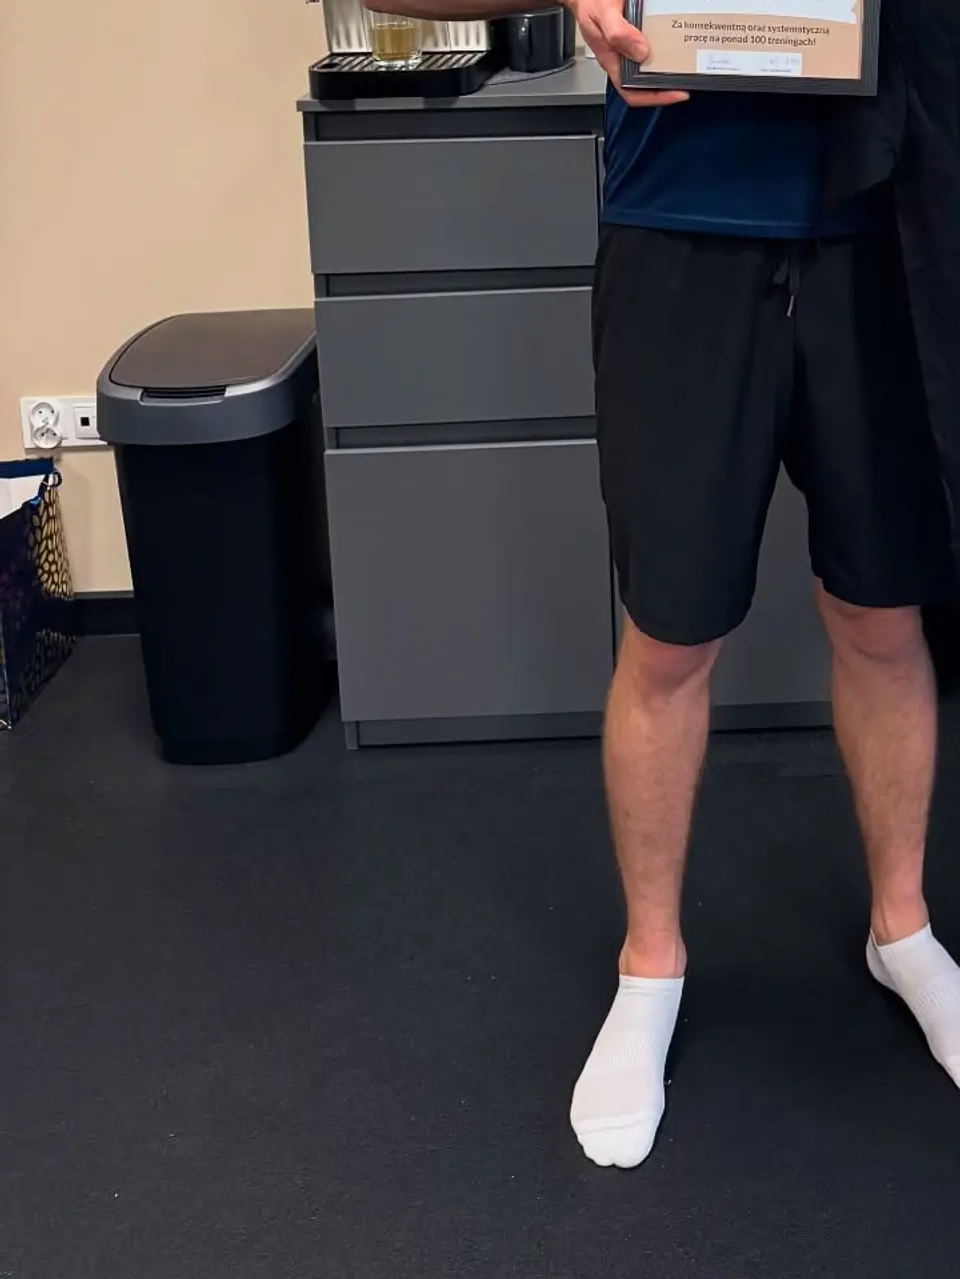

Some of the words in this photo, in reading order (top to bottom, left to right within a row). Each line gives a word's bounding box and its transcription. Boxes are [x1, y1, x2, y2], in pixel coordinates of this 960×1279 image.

[672, 20, 682, 28] Za
[684, 21, 746, 32] konsekwentną
[684, 35, 708, 43] pracę
[721, 35, 748, 44] ponad
[751, 35, 766, 44] 100
[768, 37, 816, 47] treningach!
